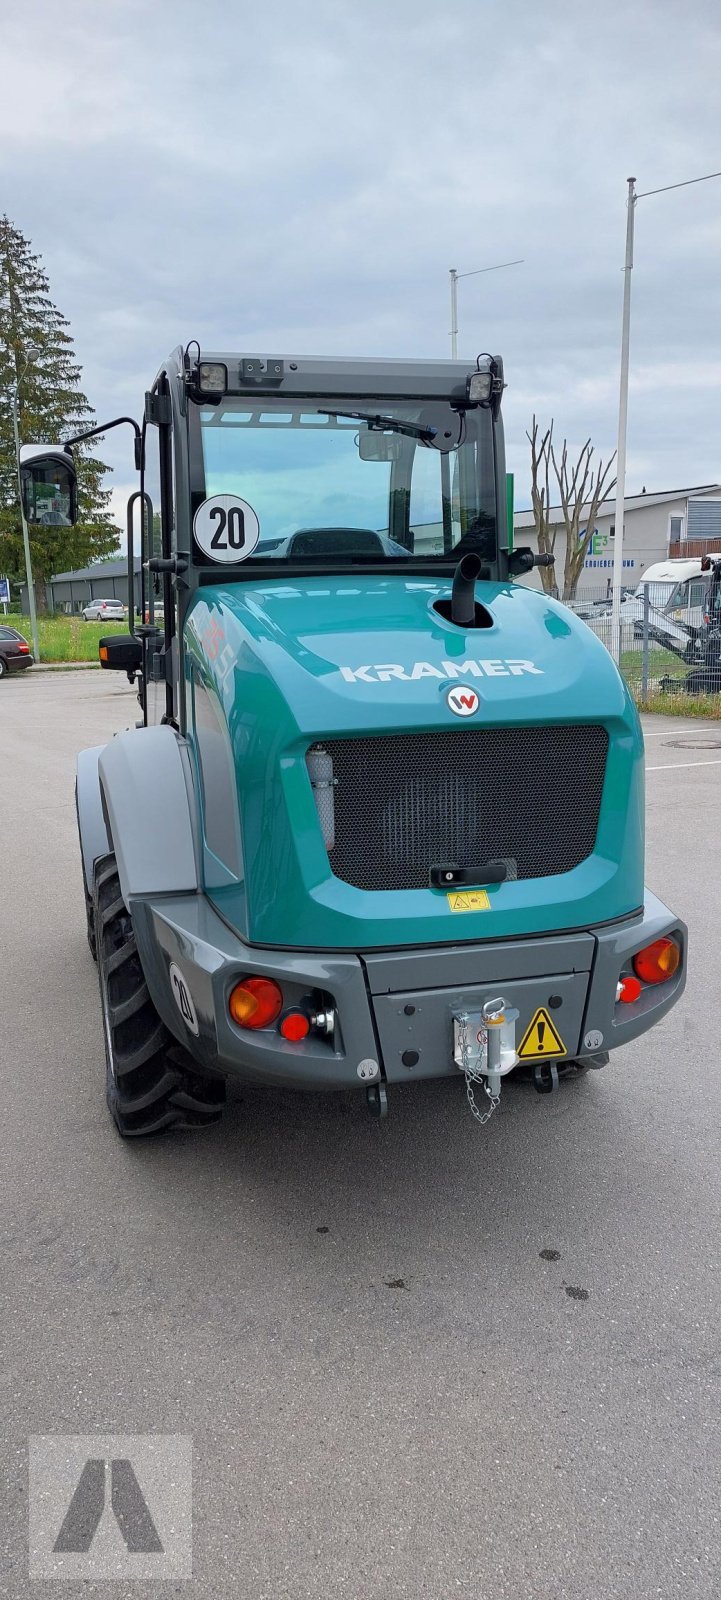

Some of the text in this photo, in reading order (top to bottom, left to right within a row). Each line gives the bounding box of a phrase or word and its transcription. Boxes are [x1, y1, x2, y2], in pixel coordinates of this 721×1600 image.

[210, 507, 245, 550] 20
[339, 659, 545, 683] KRAMER
[173, 974, 195, 1025] 20
